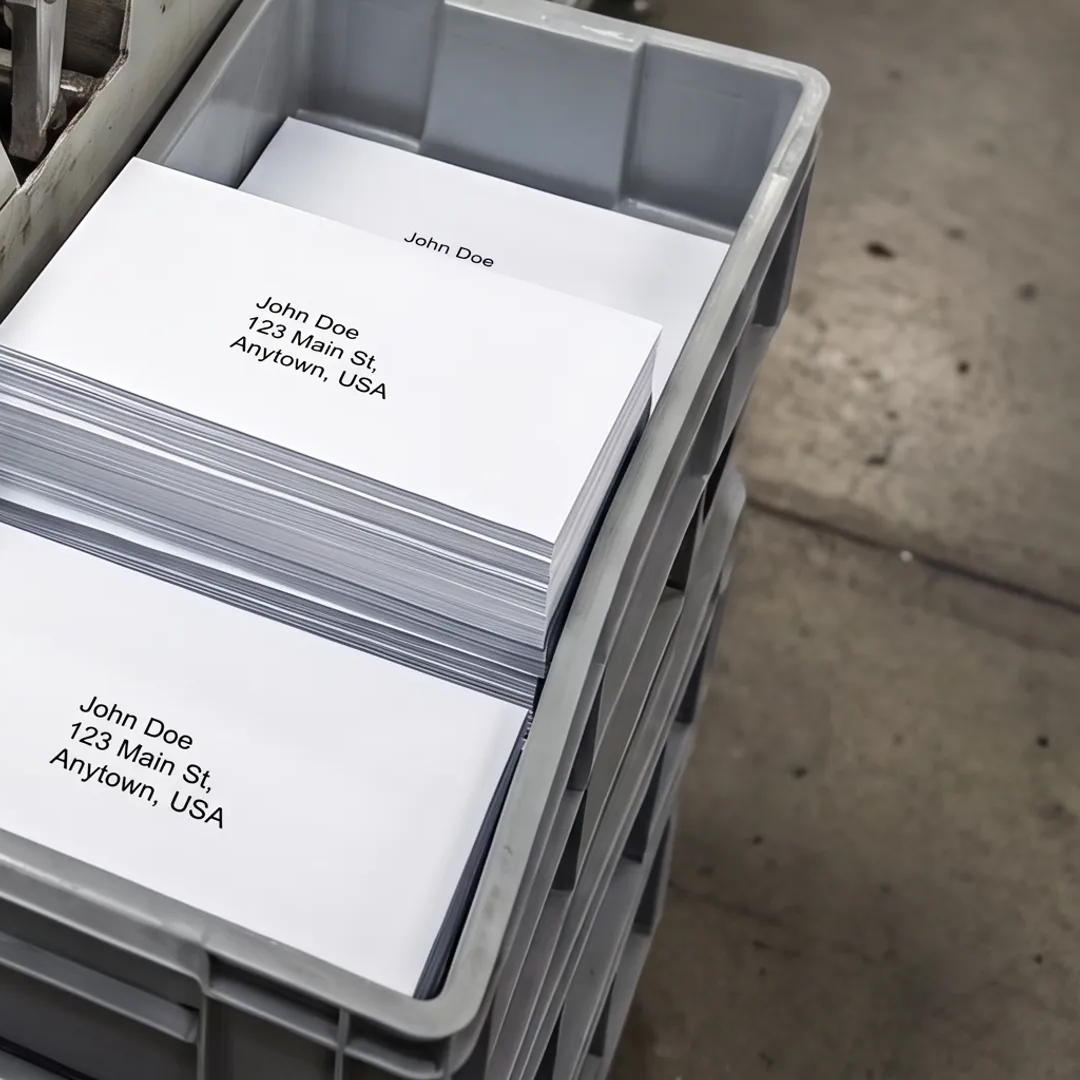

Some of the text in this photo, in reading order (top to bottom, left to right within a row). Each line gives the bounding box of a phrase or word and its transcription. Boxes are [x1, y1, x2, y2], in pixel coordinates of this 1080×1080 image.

[403, 232, 495, 268] John Doe
[248, 316, 377, 374] 123 Main St,
[255, 296, 360, 340] John Doe
[229, 335, 388, 400] Anytown, USA
[79, 696, 194, 750] John Doe
[70, 721, 212, 795] 123 Main St,
[48, 747, 224, 830] Anytown, USA
